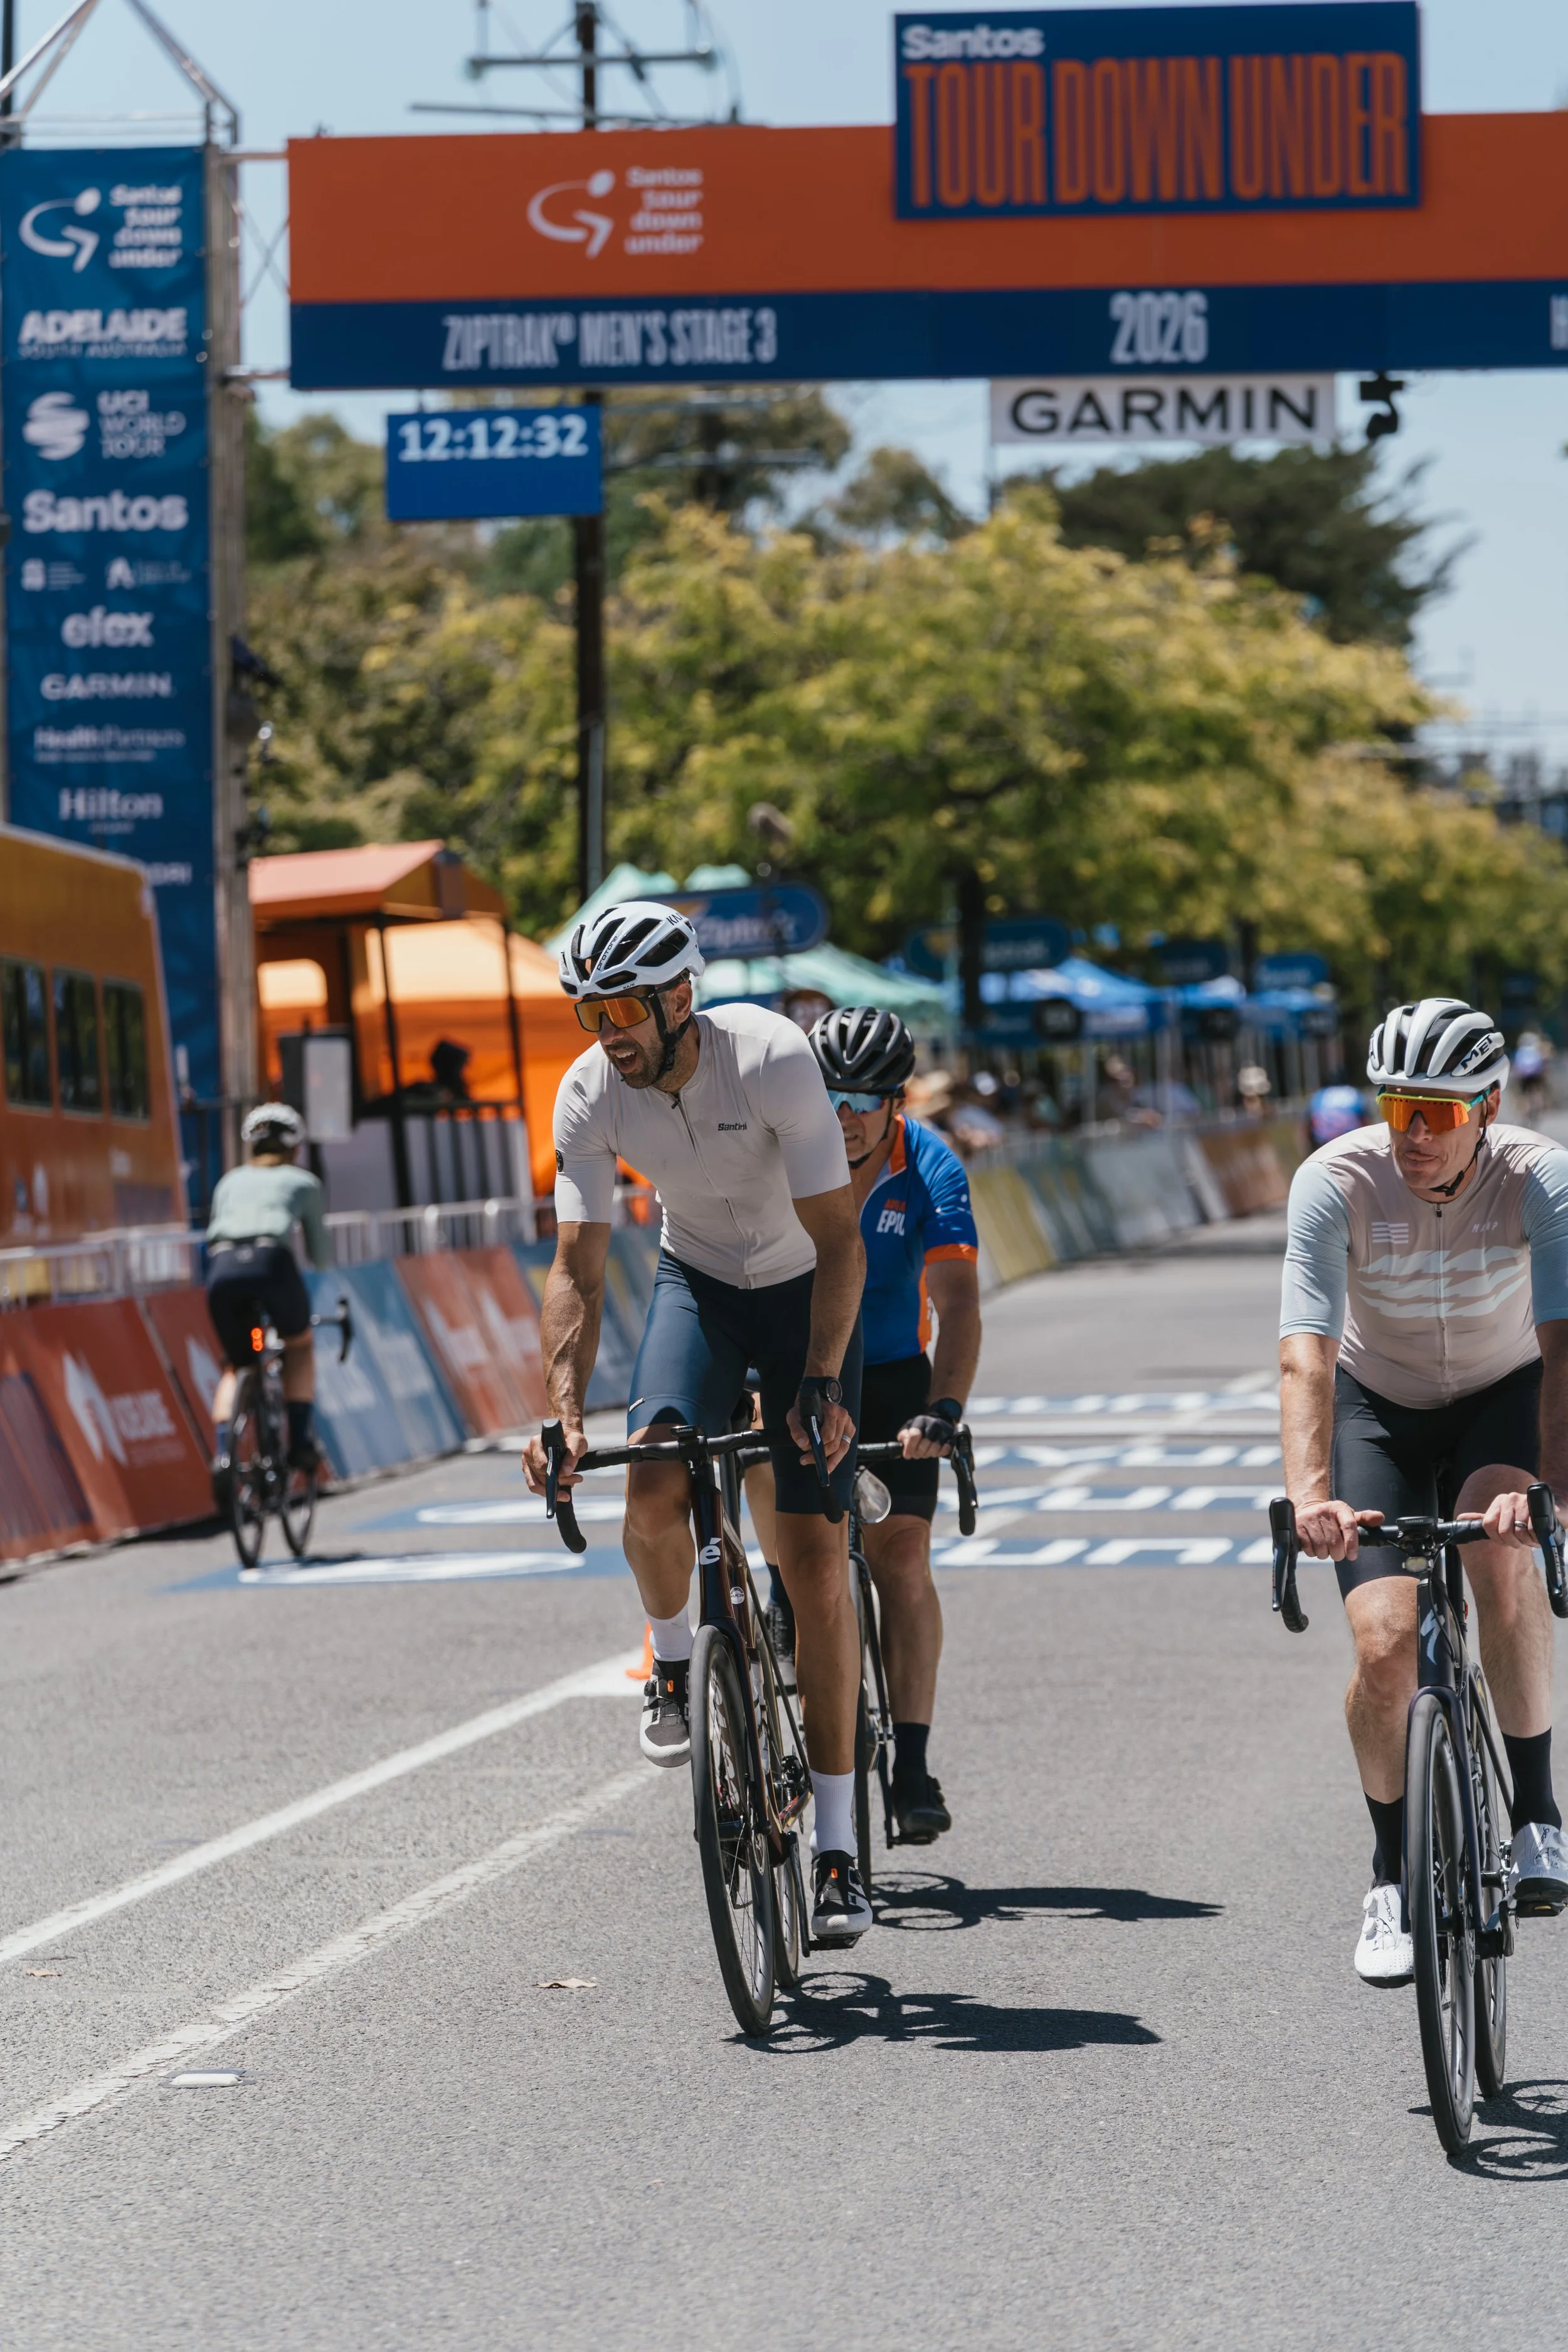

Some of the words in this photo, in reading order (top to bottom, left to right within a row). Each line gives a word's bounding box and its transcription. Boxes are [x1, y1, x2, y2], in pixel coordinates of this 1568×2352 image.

[902, 24, 1045, 59] Santos
[903, 61, 1047, 208] TOUR
[1052, 56, 1222, 204] DOWN
[1229, 51, 1409, 198] UNDER
[625, 166, 704, 188] Santos
[109, 184, 182, 206] Santos
[19, 309, 186, 344] ADELAIDE
[580, 310, 667, 367] MEN'S
[670, 308, 753, 365] STAGE
[755, 306, 777, 364] 3
[1110, 291, 1208, 364] 2026
[97, 389, 149, 414] UCI
[1010, 386, 1318, 434] GARMIN
[98, 411, 186, 437] WORLD
[398, 414, 588, 461] 12:12:32
[99, 437, 166, 459] TOUR
[23, 489, 188, 533] Santos
[40, 672, 171, 701] GARMIN
[59, 787, 163, 820] Hilton
[1459, 1034, 1493, 1070] MET
[718, 1122, 747, 1131] Santini
